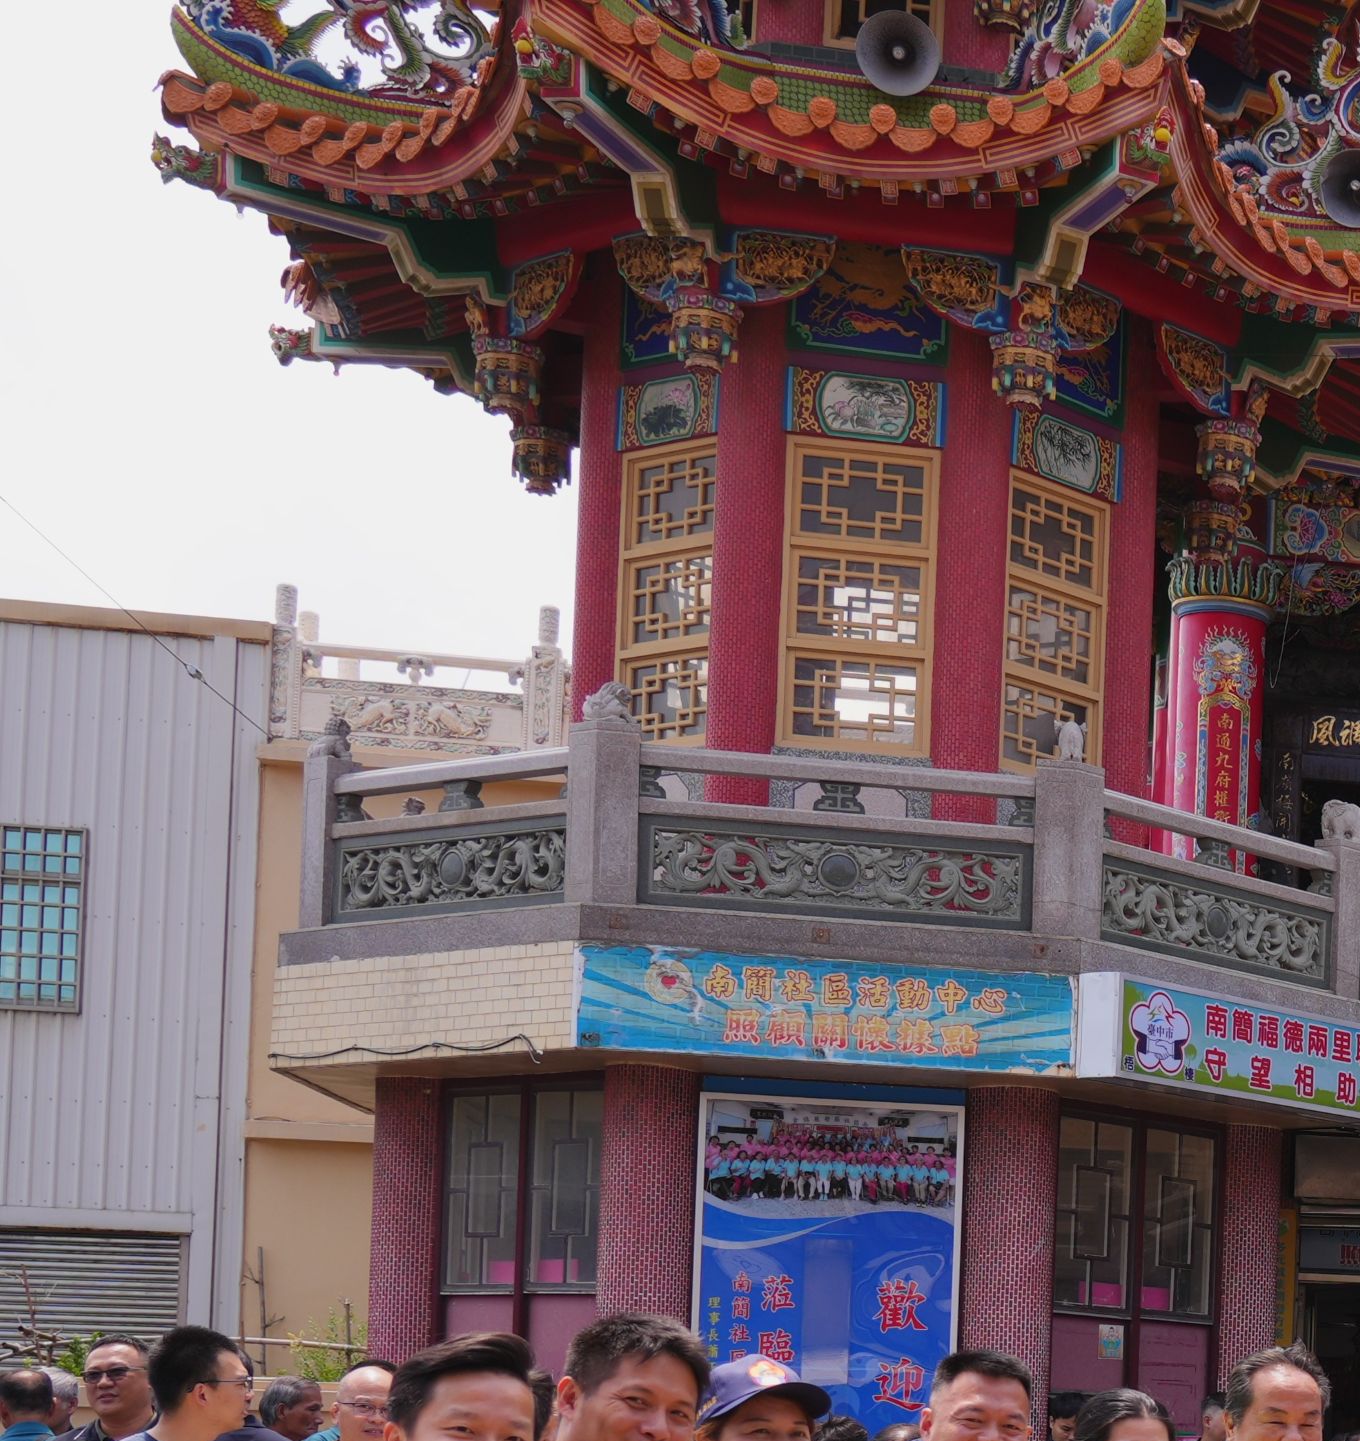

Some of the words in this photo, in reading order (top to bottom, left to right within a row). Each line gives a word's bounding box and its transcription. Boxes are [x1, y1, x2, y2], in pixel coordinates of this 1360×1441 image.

[703, 964, 1007, 1015] 南簡社區活動中心
[721, 1008, 981, 1058] 照顧關懷據點
[757, 1275, 797, 1363] 蒞臨
[873, 1278, 930, 1413] 歡迎
